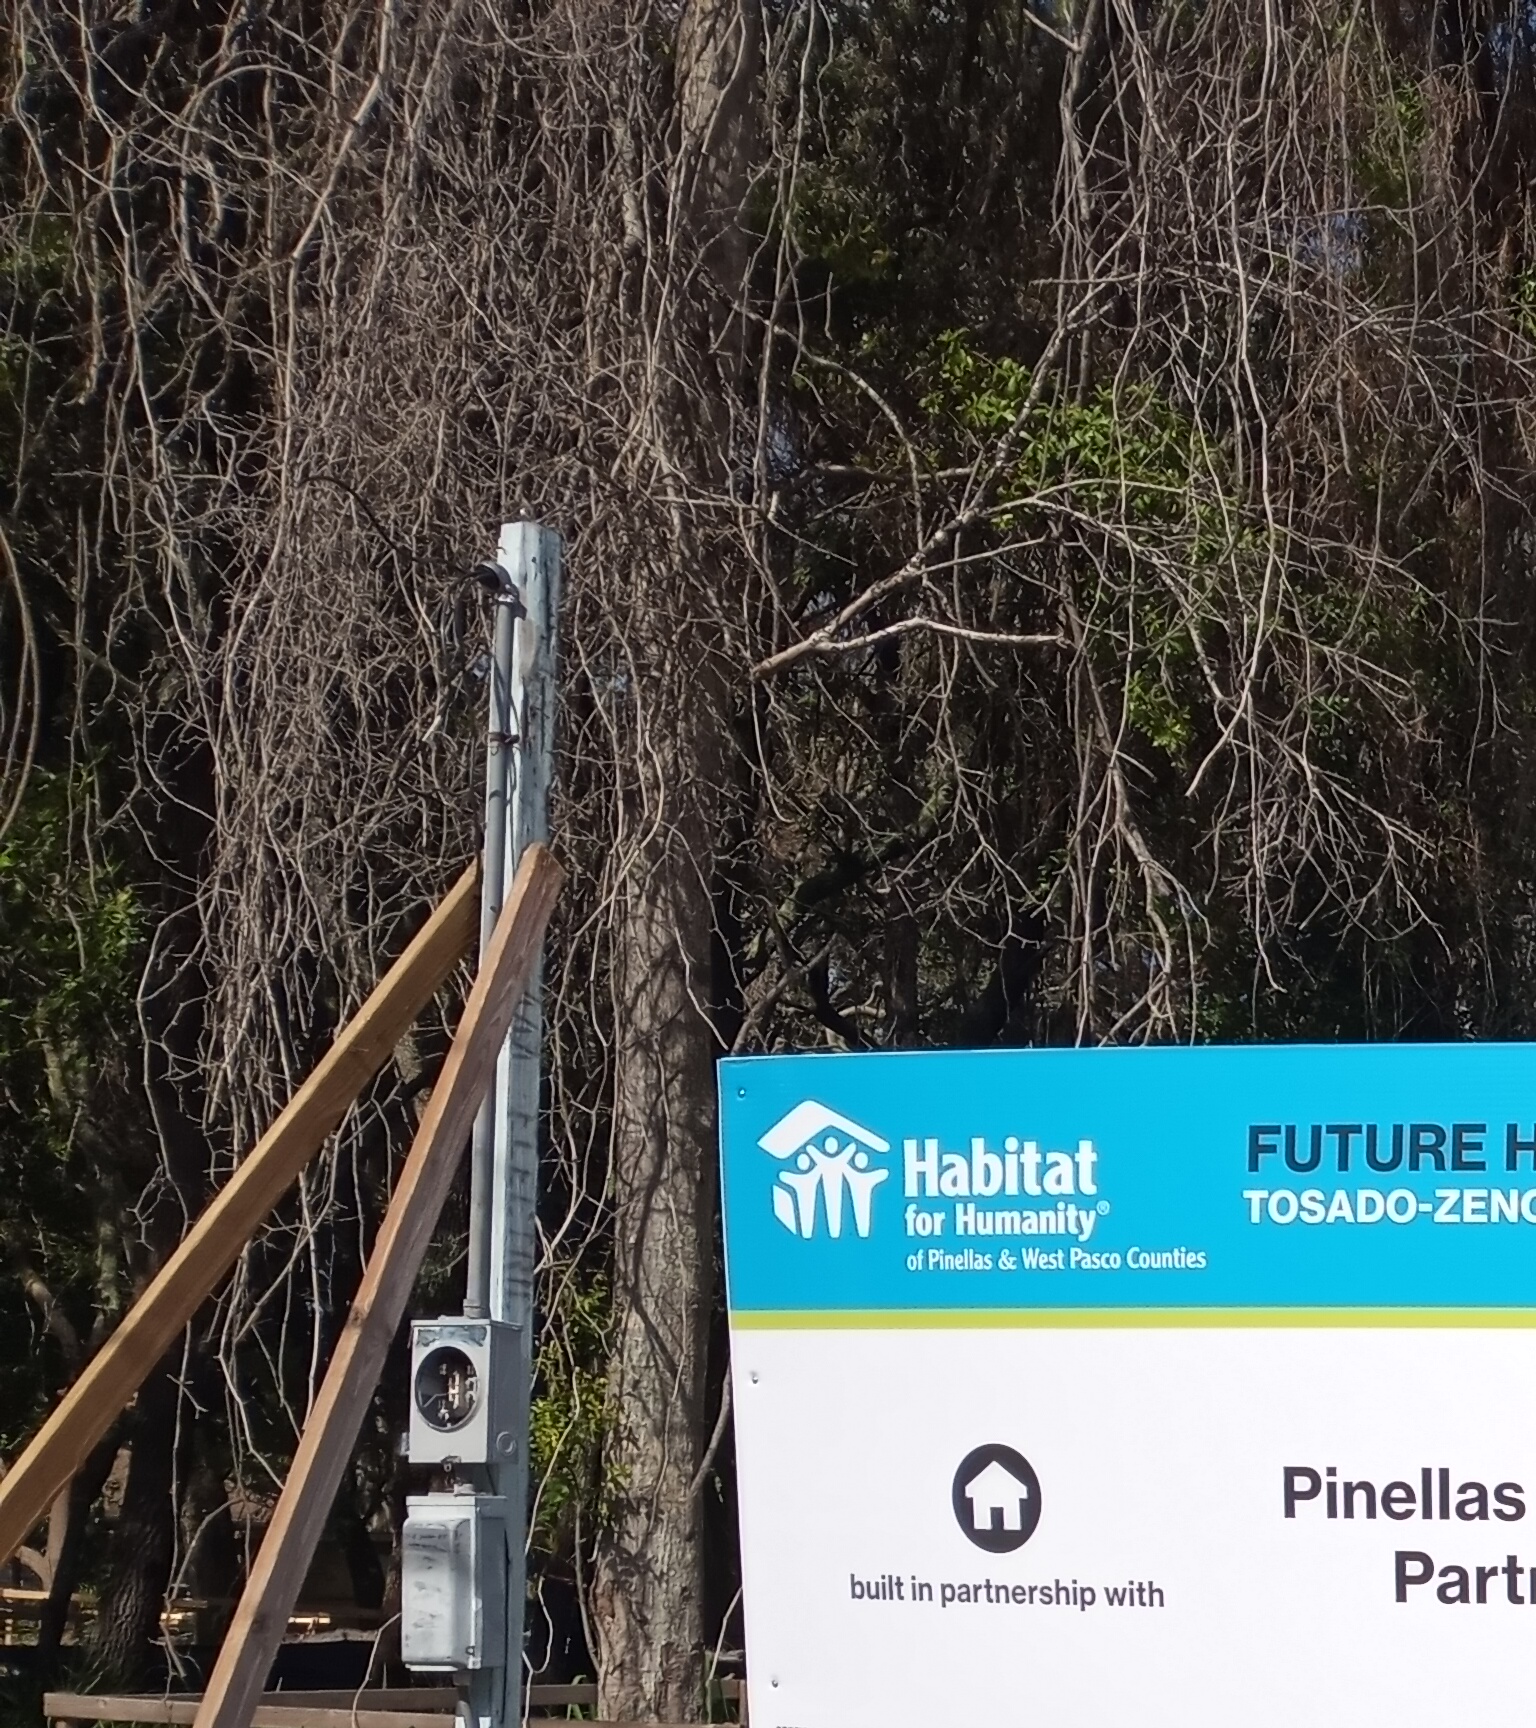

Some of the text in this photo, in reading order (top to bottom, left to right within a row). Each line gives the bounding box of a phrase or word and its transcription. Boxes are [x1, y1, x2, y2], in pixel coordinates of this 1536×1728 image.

[903, 1137, 1097, 1198] Habitat
[1248, 1124, 1486, 1172] FUTURE
[905, 1204, 945, 1236] for
[907, 1247, 1206, 1270] of Pinellas & West Pasco Counties
[1283, 1466, 1525, 1521] Pinellas
[851, 1574, 1164, 1611] built in partnership with
